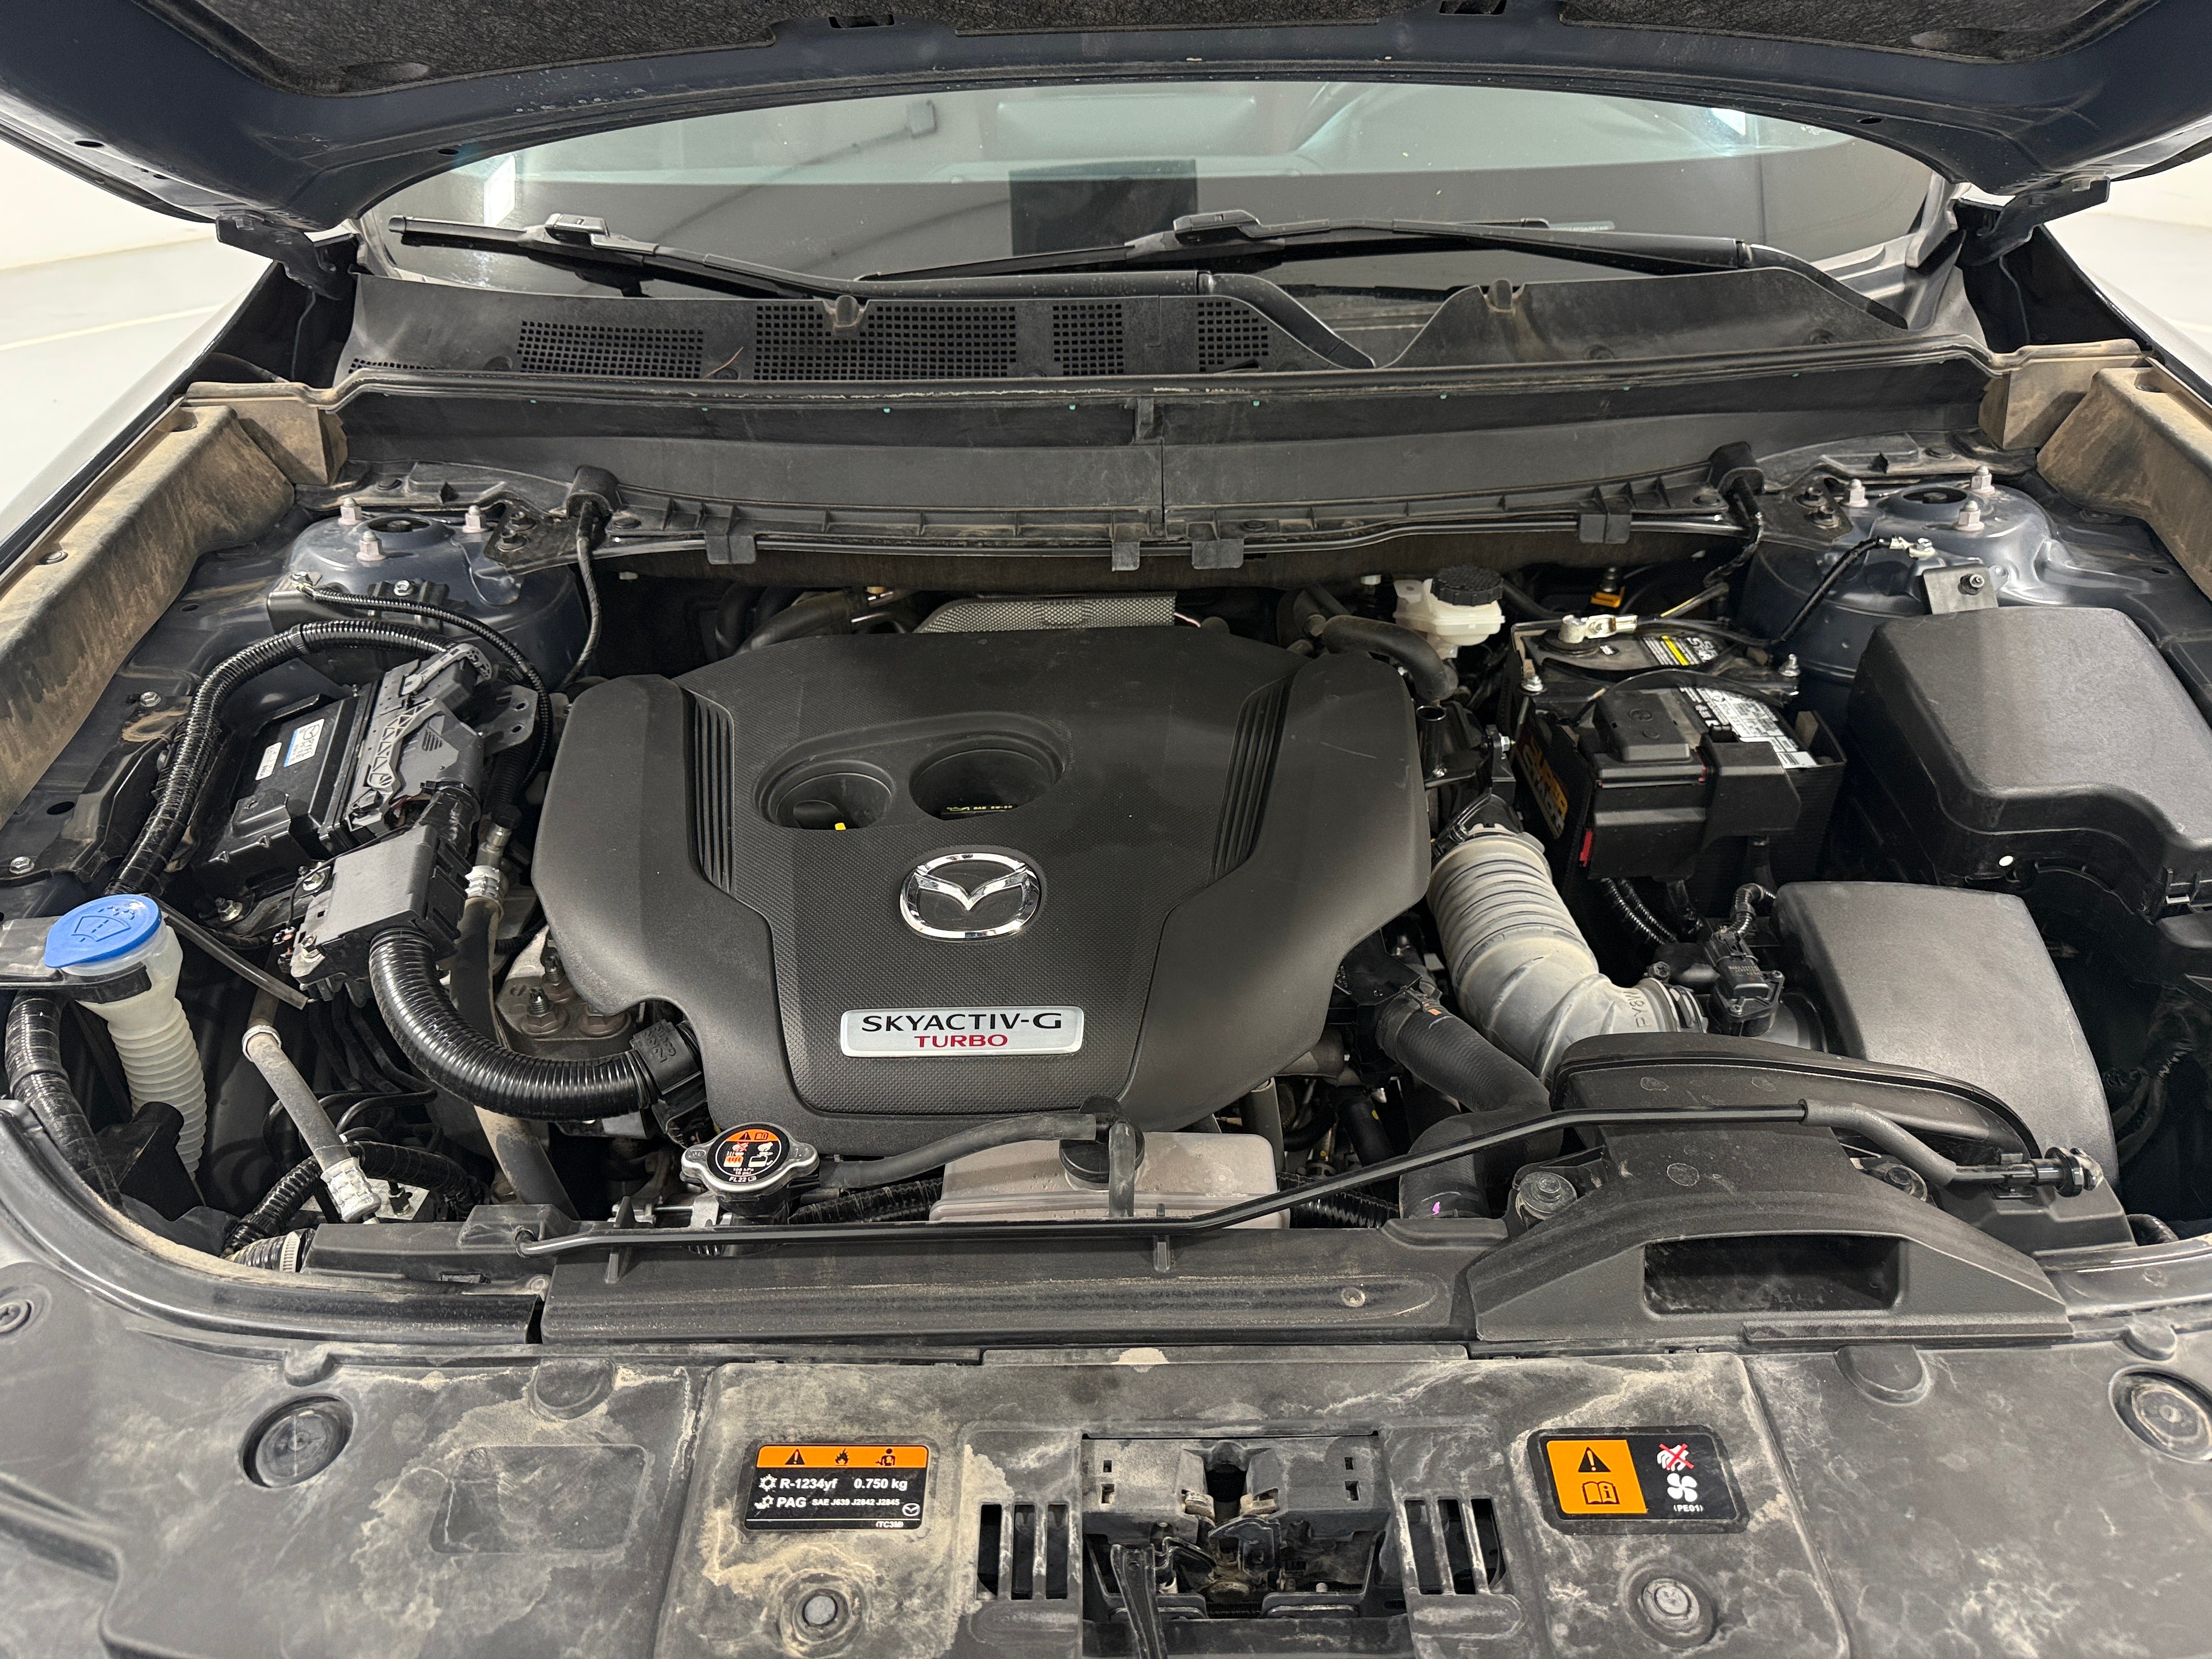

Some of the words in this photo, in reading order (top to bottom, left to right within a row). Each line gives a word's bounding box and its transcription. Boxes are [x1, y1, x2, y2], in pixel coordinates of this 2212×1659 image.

[861, 1012, 1062, 1032] SKYACTIV-G
[914, 1034, 1008, 1048] TURBO
[780, 1478, 838, 1491] R-1234yf
[854, 1479, 888, 1489] 0.750
[891, 1478, 907, 1491] kg
[777, 1497, 806, 1508] PAG
[1673, 1504, 1703, 1513] (PE01)
